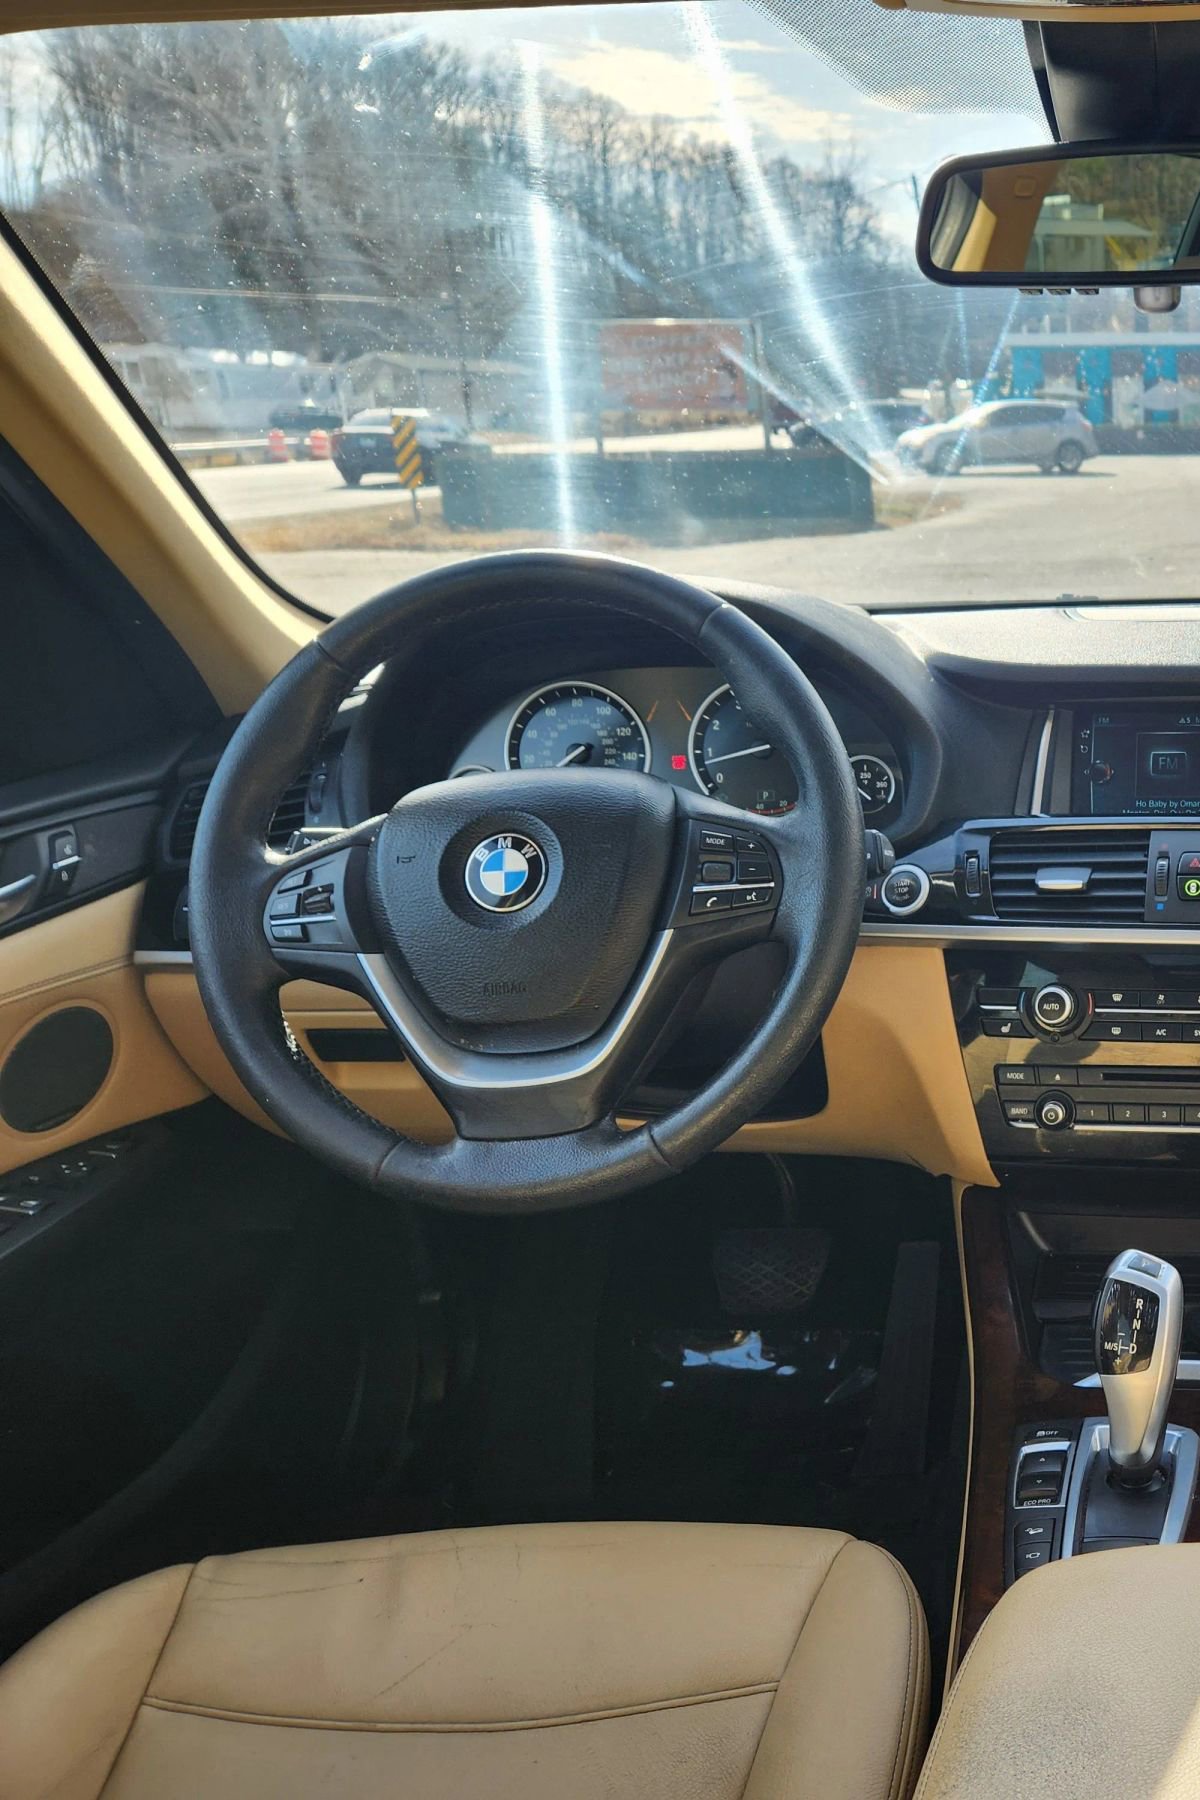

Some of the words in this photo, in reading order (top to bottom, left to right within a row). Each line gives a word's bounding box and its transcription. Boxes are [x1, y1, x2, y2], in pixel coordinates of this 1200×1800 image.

[545, 708, 556, 716] 60
[596, 707, 611, 715] 100
[712, 721, 720, 730] 2
[616, 728, 631, 737] 120
[707, 747, 713, 757] 1
[623, 753, 637, 761] 140
[1159, 757, 1178, 769] FM
[716, 773, 724, 783] 0
[1149, 800, 1167, 809] Baby
[1169, 800, 1178, 809] by
[706, 837, 726, 846] MODE
[475, 837, 538, 862] BMW
[1043, 1002, 1060, 1011] AUTO
[1155, 1028, 1167, 1037] A/C
[1006, 1072, 1025, 1080] MODE
[1011, 1107, 1028, 1115] BAND
[1135, 1299, 1144, 1309] R
[1132, 1319, 1141, 1330] N
[1104, 1342, 1119, 1351] M/S
[1129, 1343, 1138, 1354] D
